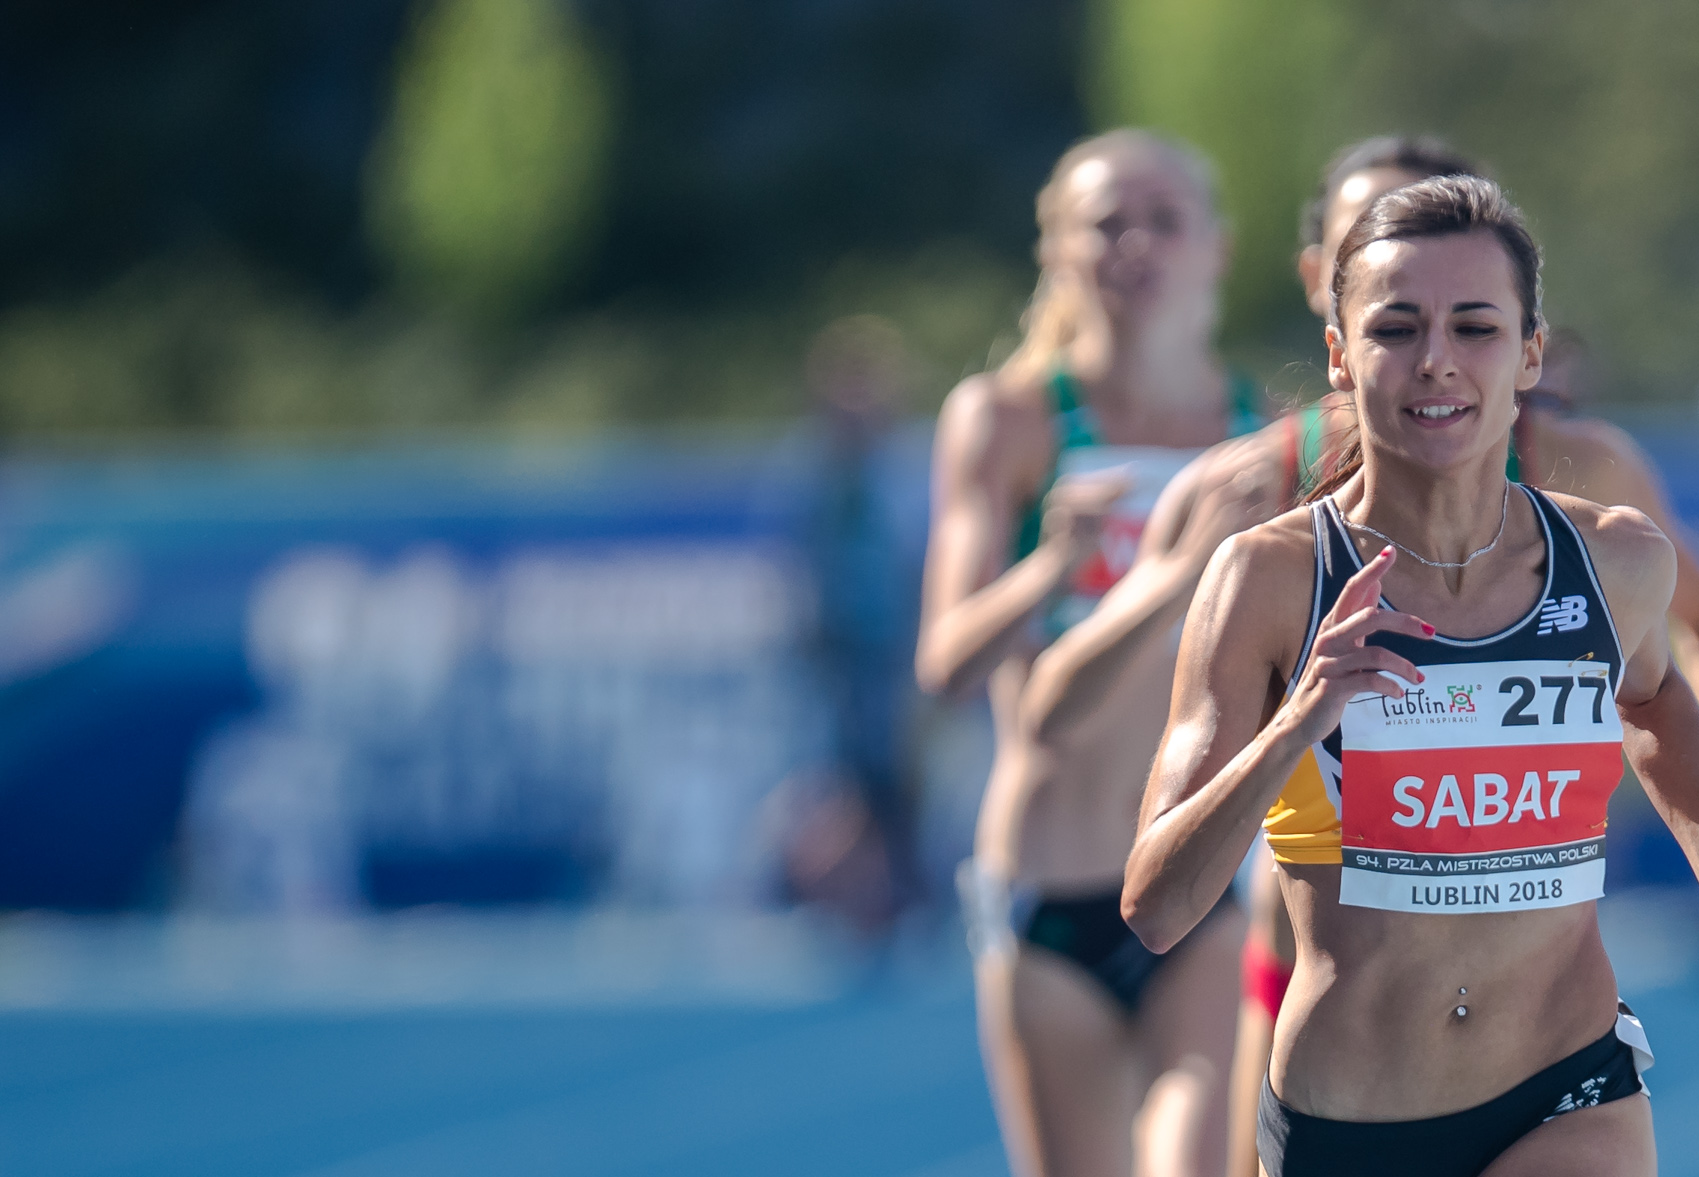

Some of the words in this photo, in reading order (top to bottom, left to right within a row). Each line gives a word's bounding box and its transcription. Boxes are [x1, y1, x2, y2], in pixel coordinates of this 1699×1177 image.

[1498, 676, 1607, 727] 277
[1385, 718, 1421, 727] MIASTO
[1425, 715, 1478, 726] INSPIRACJI
[1391, 769, 1581, 829] SABAT
[1356, 854, 1382, 868] 94.
[1387, 858, 1434, 872] PZLA
[1437, 852, 1555, 872] MISTRZOSTWA
[1558, 843, 1599, 862] POLSKI
[1411, 883, 1499, 906] LUBLIN
[1508, 878, 1563, 903] 2018
